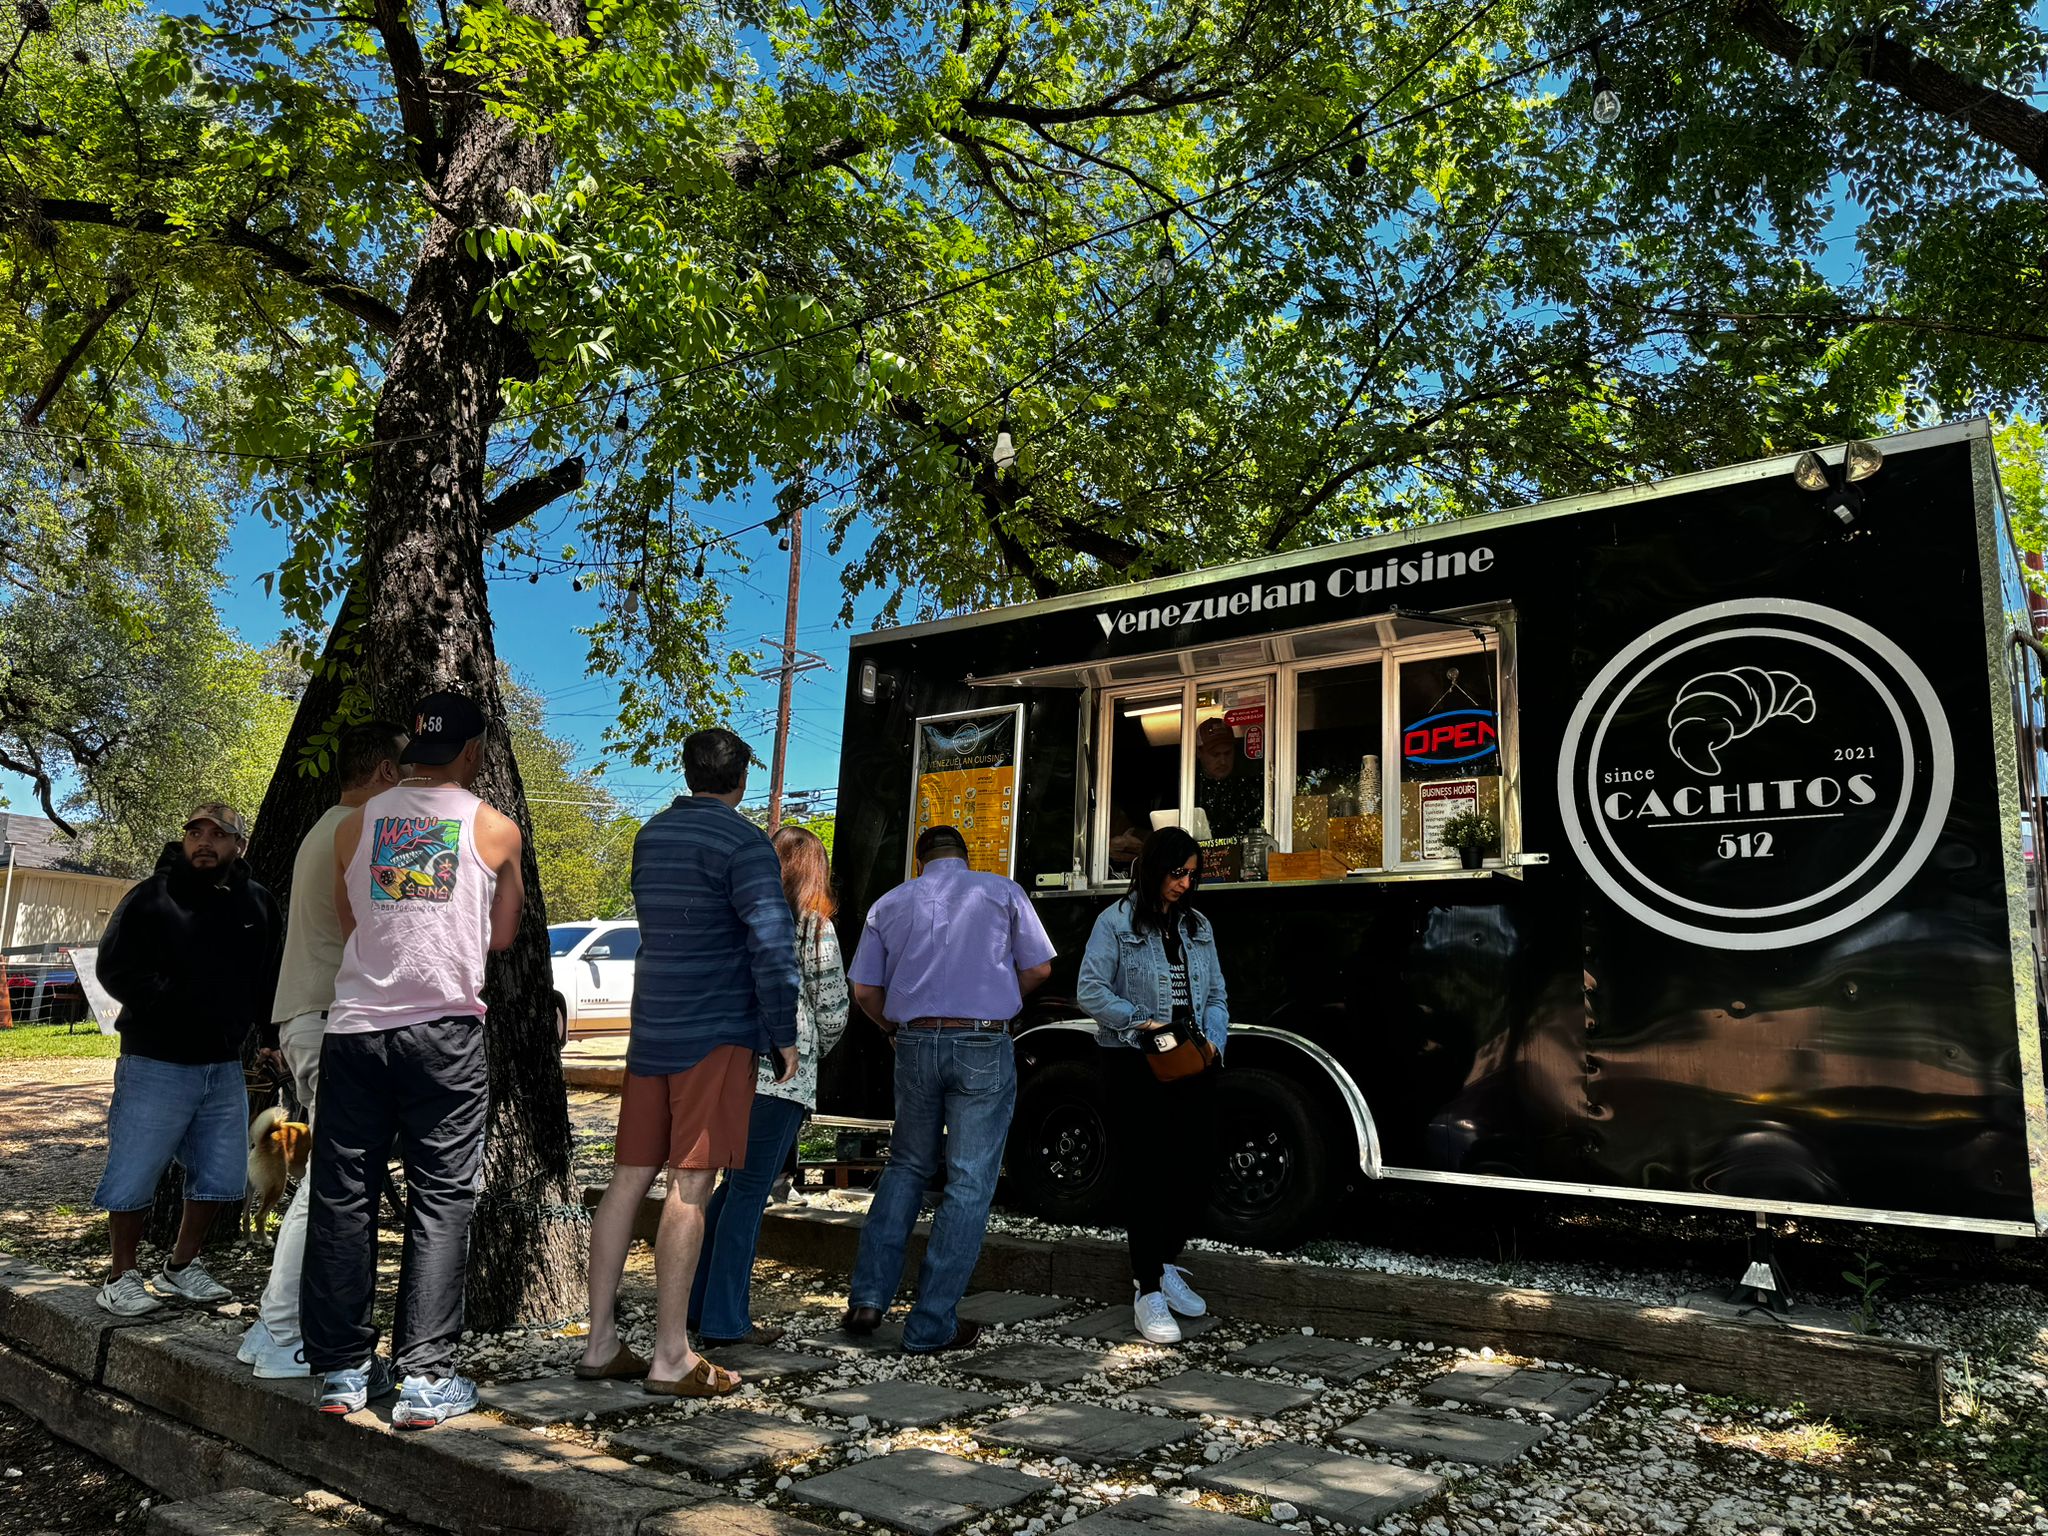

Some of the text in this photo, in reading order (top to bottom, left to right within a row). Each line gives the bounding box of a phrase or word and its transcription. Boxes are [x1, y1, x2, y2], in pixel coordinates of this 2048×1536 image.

[1096, 547, 1495, 640] Venezuelan Cuisine
[1404, 720, 1496, 756] OPEN
[928, 753, 1005, 769] VENEZUELAN CUISINE
[1833, 746, 1876, 762] 2021
[1604, 768, 1655, 784] since
[1422, 784, 1476, 798] BUSINESS HOURS
[1604, 773, 1877, 821] CACHITOS
[374, 816, 439, 863] MAUI
[1716, 831, 1774, 859] 512
